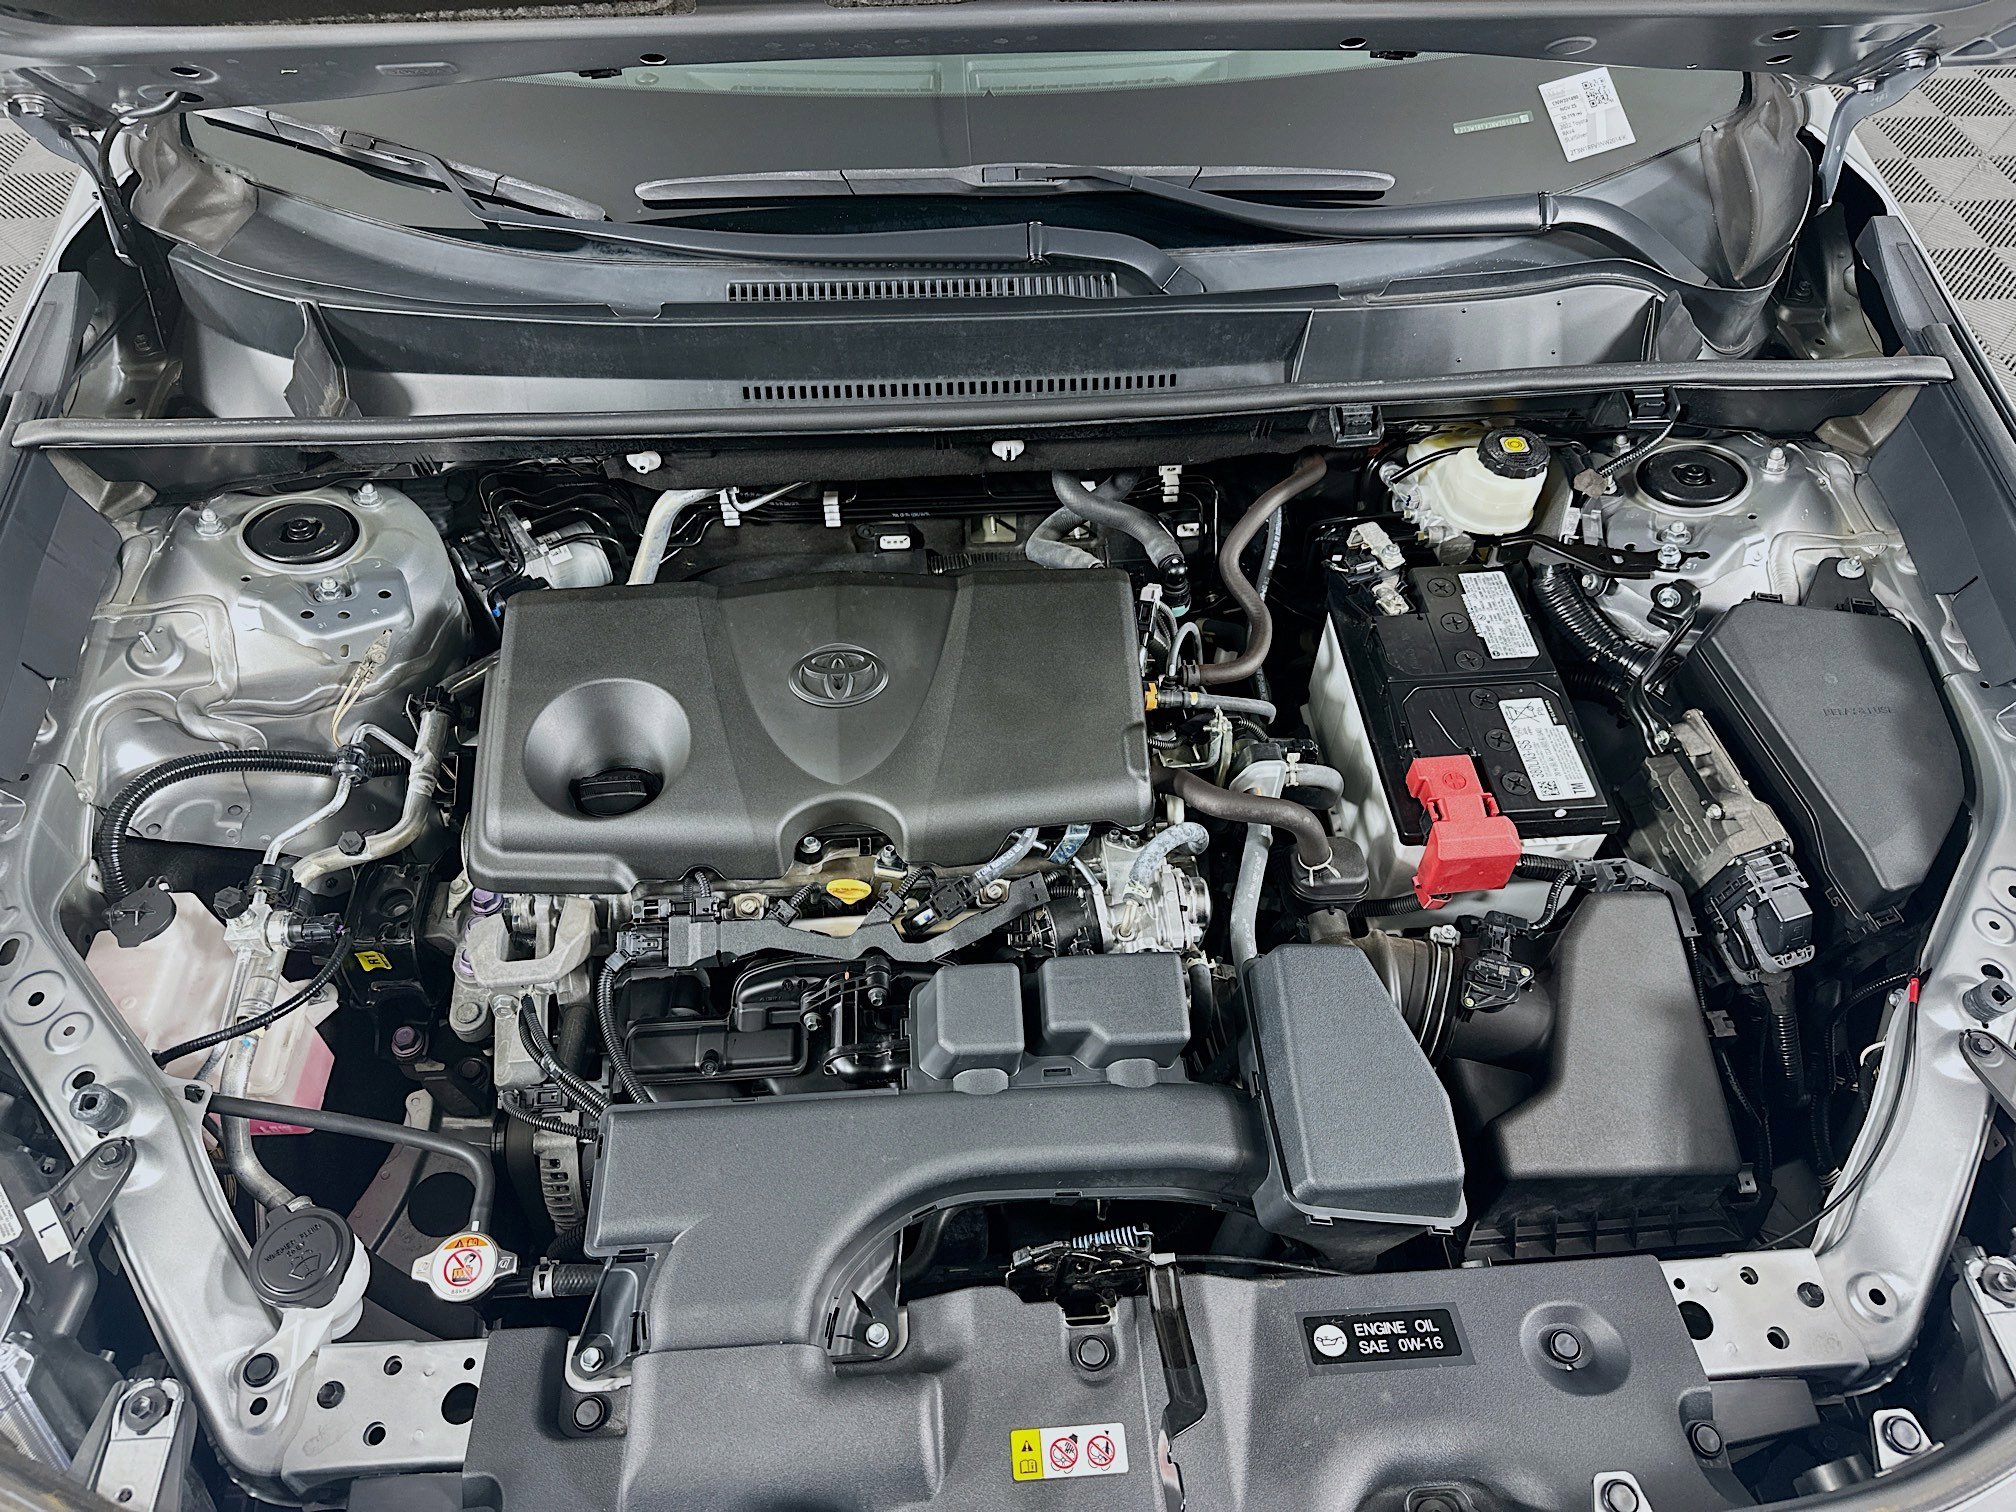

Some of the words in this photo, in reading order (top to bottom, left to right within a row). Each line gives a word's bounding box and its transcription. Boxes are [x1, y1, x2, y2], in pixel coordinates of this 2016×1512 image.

[1353, 1320, 1407, 1337] ENGINE
[1414, 1319, 1440, 1333] OIL
[1359, 1339, 1390, 1355] SAE
[1398, 1336, 1444, 1352] 0W-16
